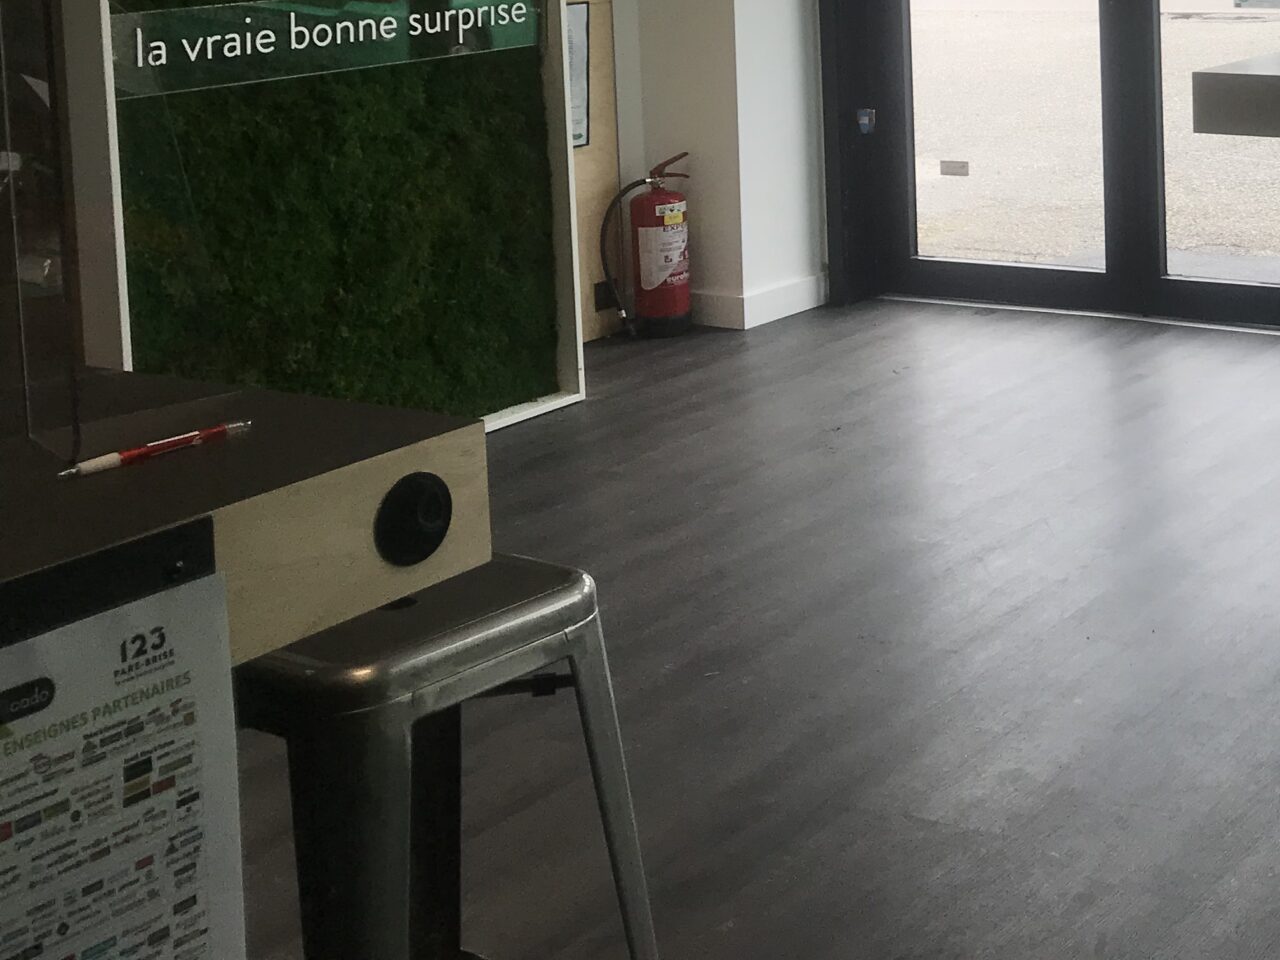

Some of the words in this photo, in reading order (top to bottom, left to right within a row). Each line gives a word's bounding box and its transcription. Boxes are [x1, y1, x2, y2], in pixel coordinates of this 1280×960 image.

[135, 25, 168, 68] la
[181, 14, 277, 63] vraie
[290, 10, 399, 52] bonne
[113, 648, 175, 678] PARE-BRISE
[120, 625, 167, 664] 123
[3, 711, 89, 757] ENSEIGNES
[91, 670, 192, 721] PARTENAIRES
